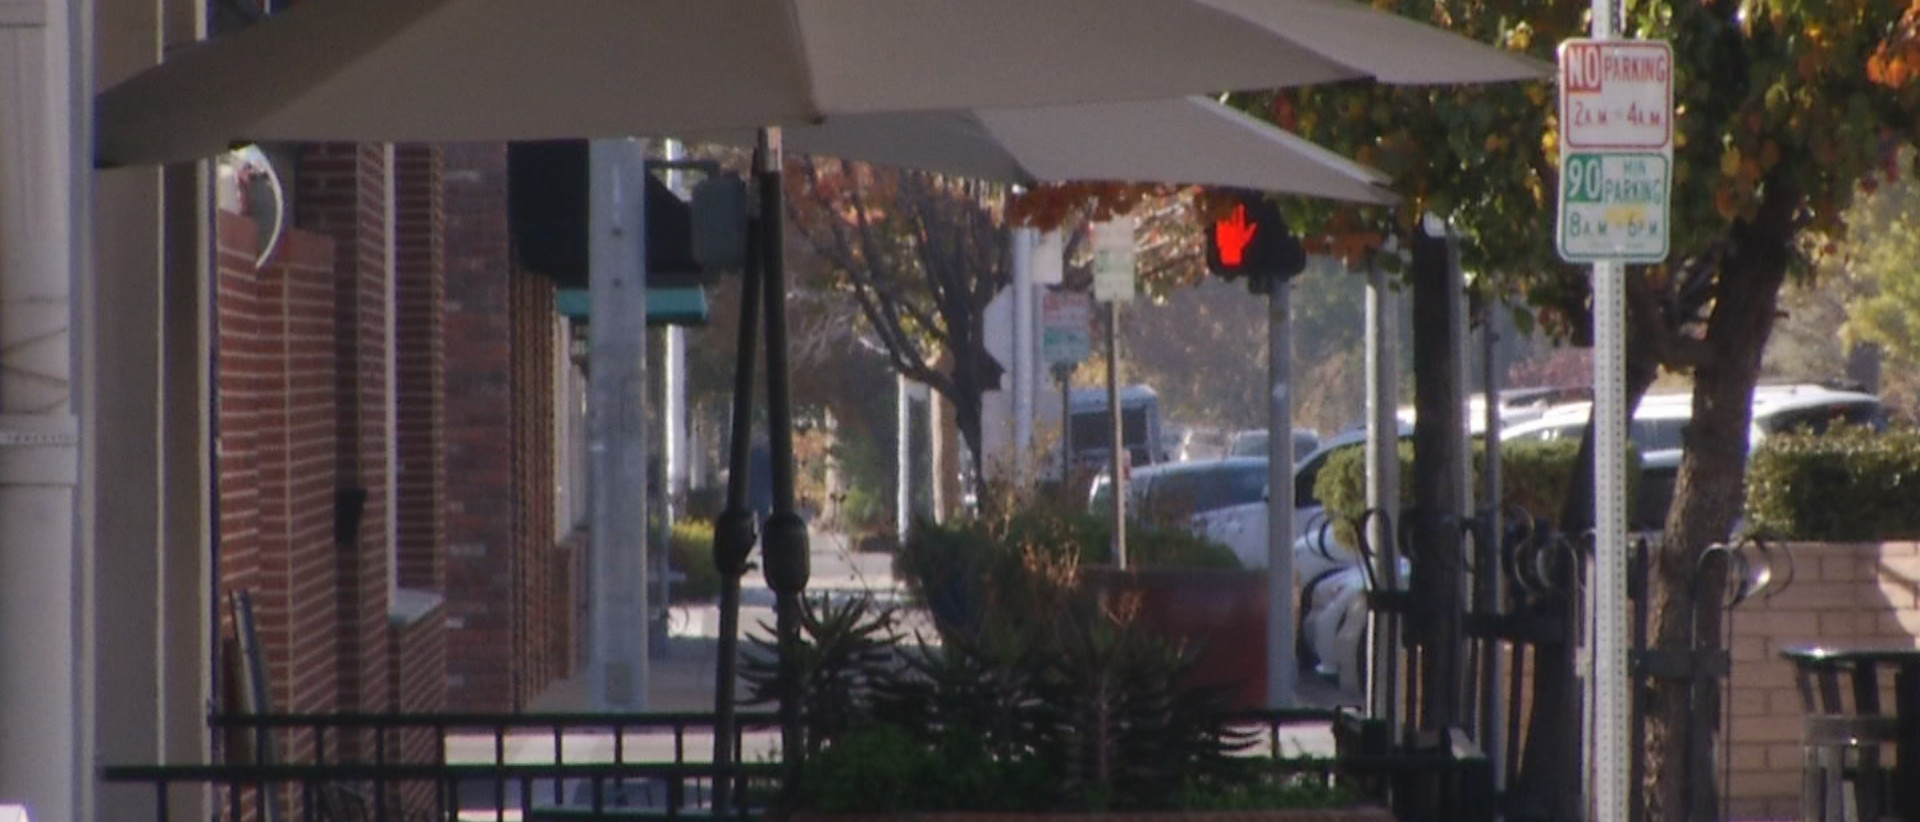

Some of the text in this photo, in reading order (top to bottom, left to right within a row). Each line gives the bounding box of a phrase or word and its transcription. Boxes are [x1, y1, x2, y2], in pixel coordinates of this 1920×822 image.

[1568, 45, 1665, 88] NO PARKING
[1568, 159, 1601, 199] 90
[1623, 161, 1646, 177] MIN
[1604, 178, 1662, 205] PARKING
